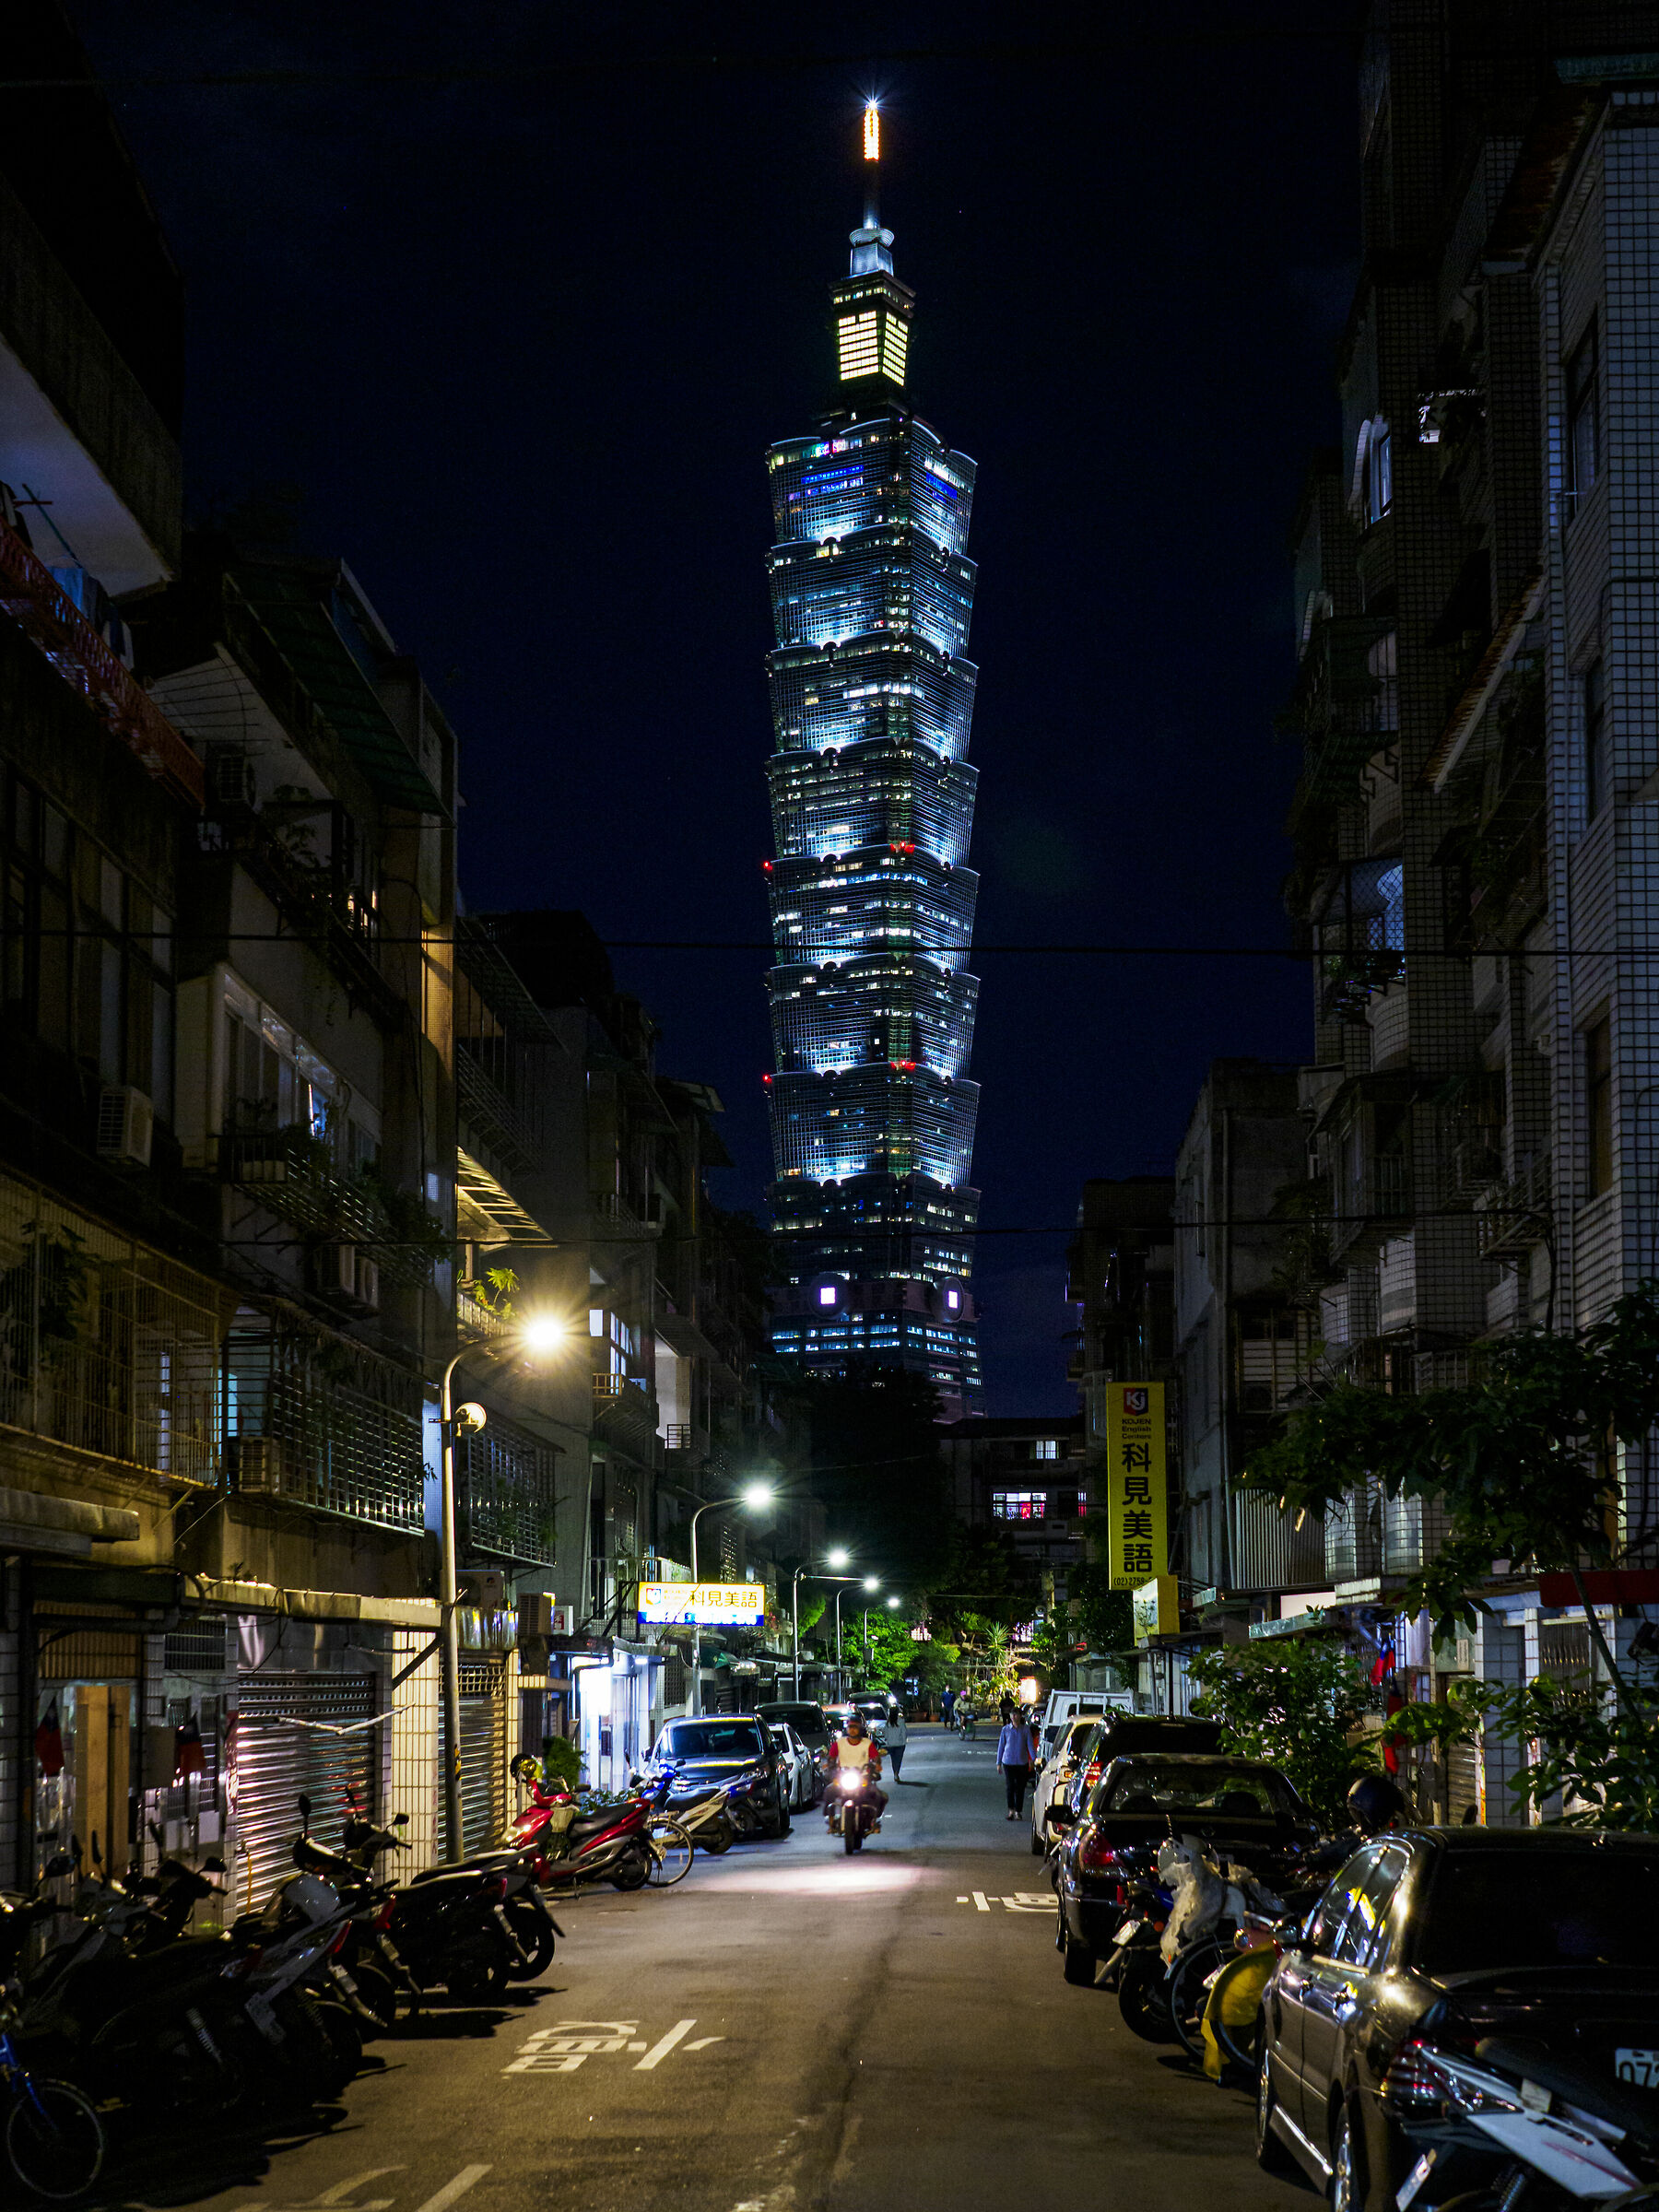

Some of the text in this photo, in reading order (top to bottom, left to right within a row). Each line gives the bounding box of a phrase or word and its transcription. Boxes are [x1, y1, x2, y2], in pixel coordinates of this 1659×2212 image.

[1122, 1442, 1153, 1572] 科見美語
[688, 1590, 758, 1608] 科見美語
